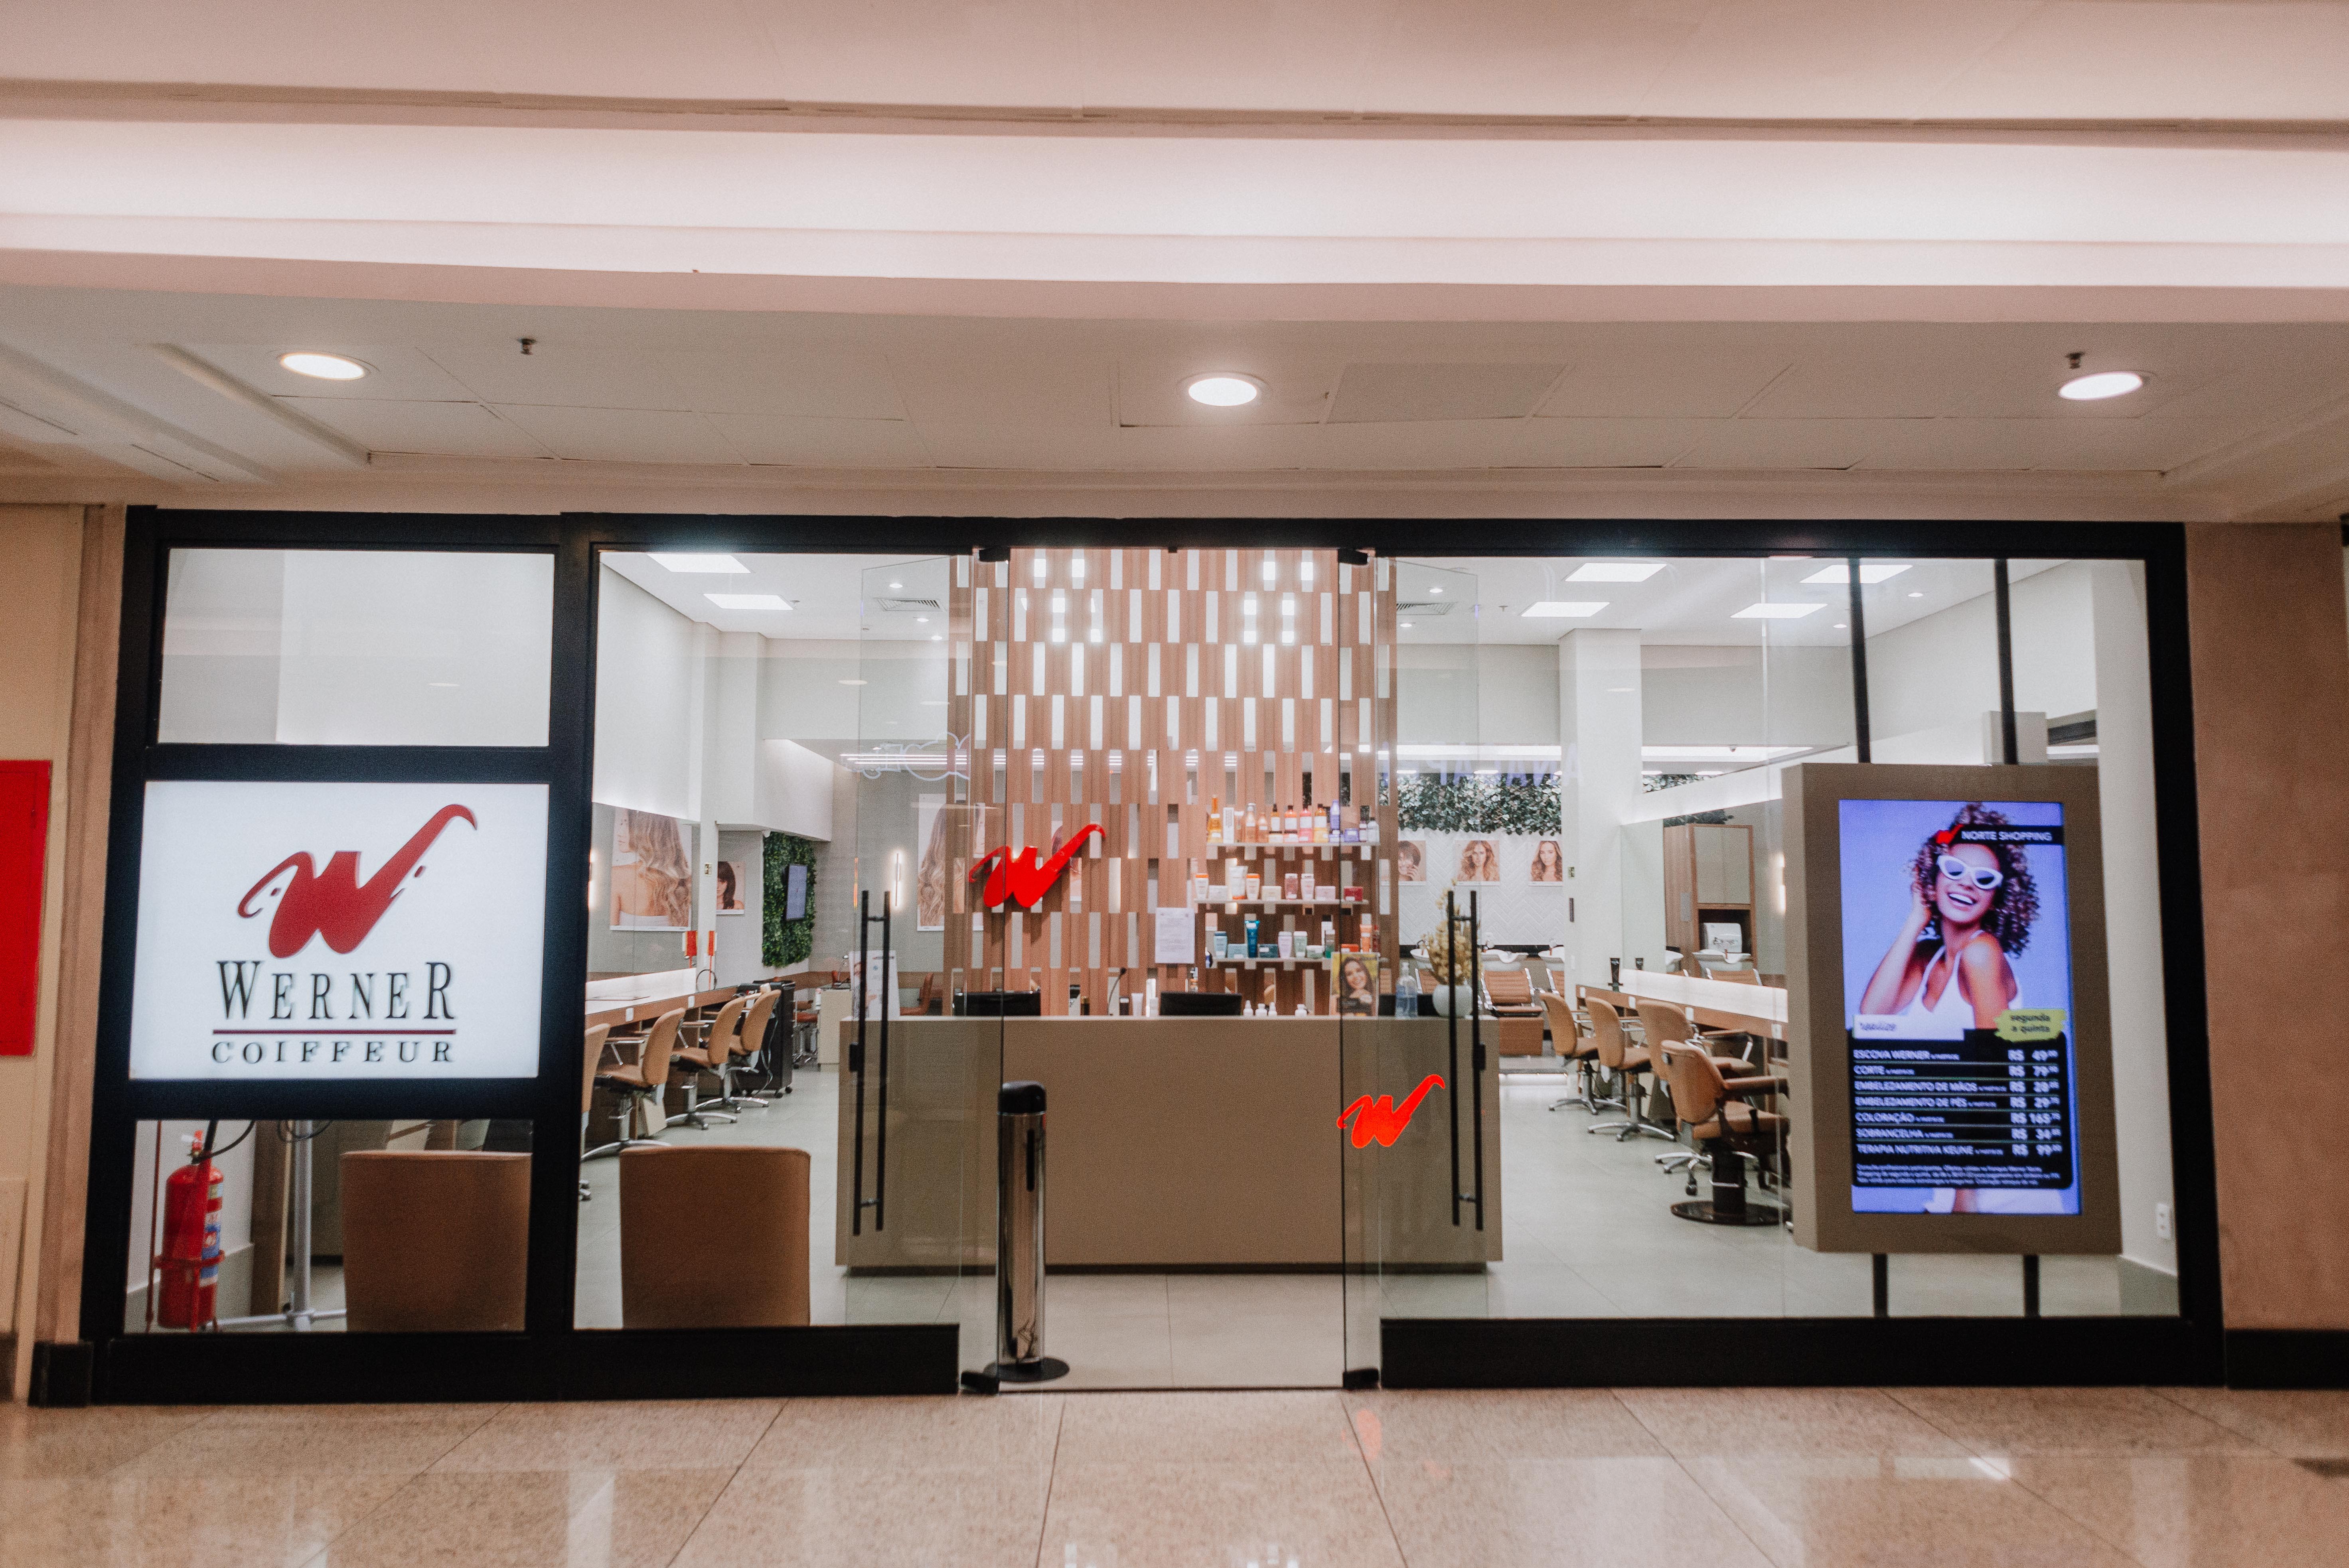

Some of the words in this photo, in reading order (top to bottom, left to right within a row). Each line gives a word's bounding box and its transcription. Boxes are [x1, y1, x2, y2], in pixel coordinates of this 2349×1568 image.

[1961, 831, 1997, 840] NORTE
[1998, 831, 2052, 841] SHOPPING
[216, 961, 456, 1020] WERNER
[212, 1041, 454, 1064] COIFFEUR
[1854, 1065, 1885, 1075] CORTE
[1856, 1112, 1915, 1124] COLORAÇÃO
